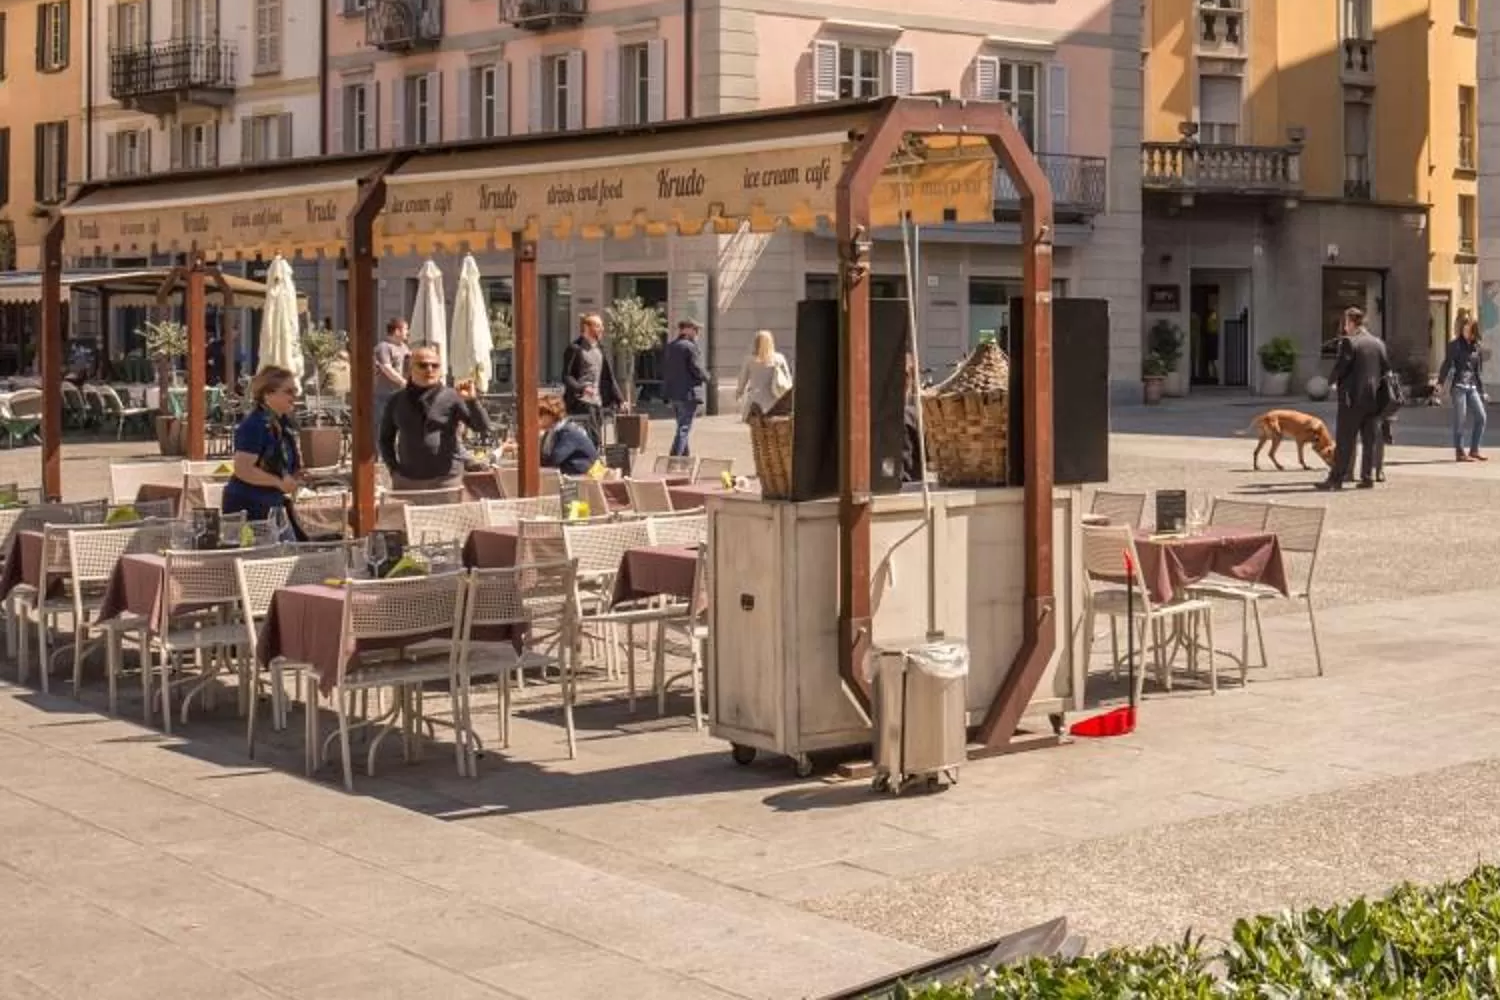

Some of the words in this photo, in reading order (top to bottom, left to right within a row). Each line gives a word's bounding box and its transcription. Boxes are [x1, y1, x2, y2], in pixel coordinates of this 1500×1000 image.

[476, 183, 519, 212] Krudo
[578, 179, 599, 202] and
[597, 177, 624, 208] food
[656, 167, 706, 200] Krudo
[743, 167, 760, 189] ice
[761, 166, 800, 188] cream
[804, 157, 832, 191] café
